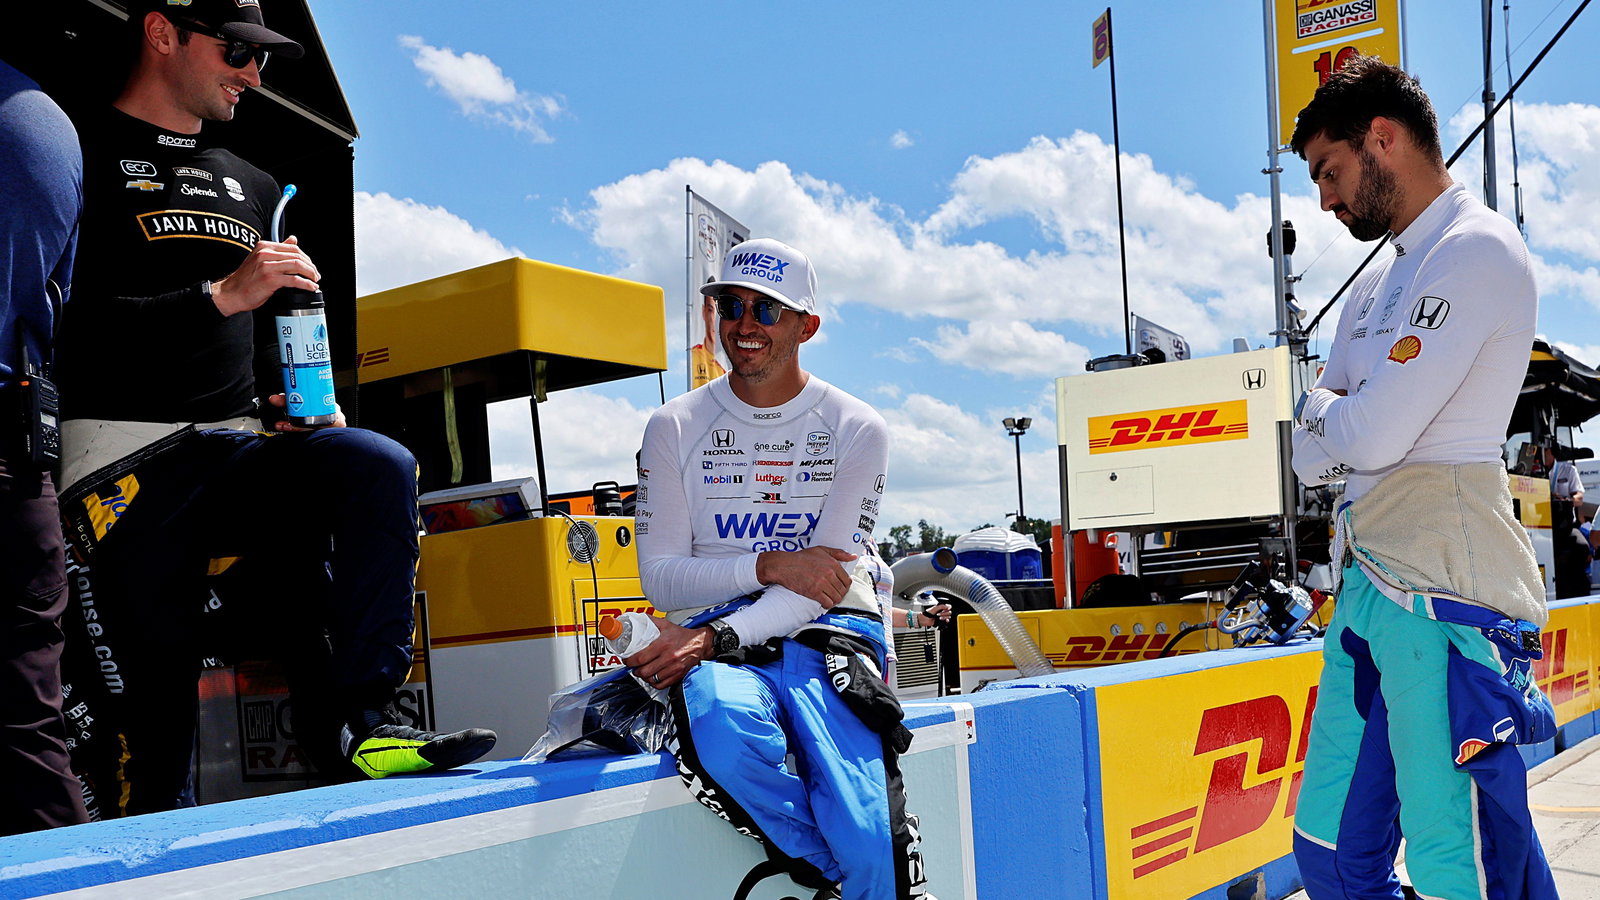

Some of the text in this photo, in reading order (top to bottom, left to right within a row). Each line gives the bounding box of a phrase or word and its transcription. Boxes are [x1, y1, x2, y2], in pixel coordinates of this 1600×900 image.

[1313, 0, 1373, 23] GANASSI
[1300, 12, 1373, 34] RACING
[157, 134, 197, 147] sparco
[191, 169, 210, 179] HOUSE
[181, 184, 218, 198] Splenda
[152, 216, 257, 247] JAVA HOUSE
[732, 252, 789, 275] WWEX
[741, 267, 783, 283] GROUP
[282, 326, 292, 335] 20
[1109, 409, 1226, 447] DHL
[704, 476, 731, 484] Mobil
[755, 473, 785, 482] Luther
[642, 510, 653, 518] Pay
[715, 513, 822, 538] WWEX
[1064, 634, 1179, 662] DHL
